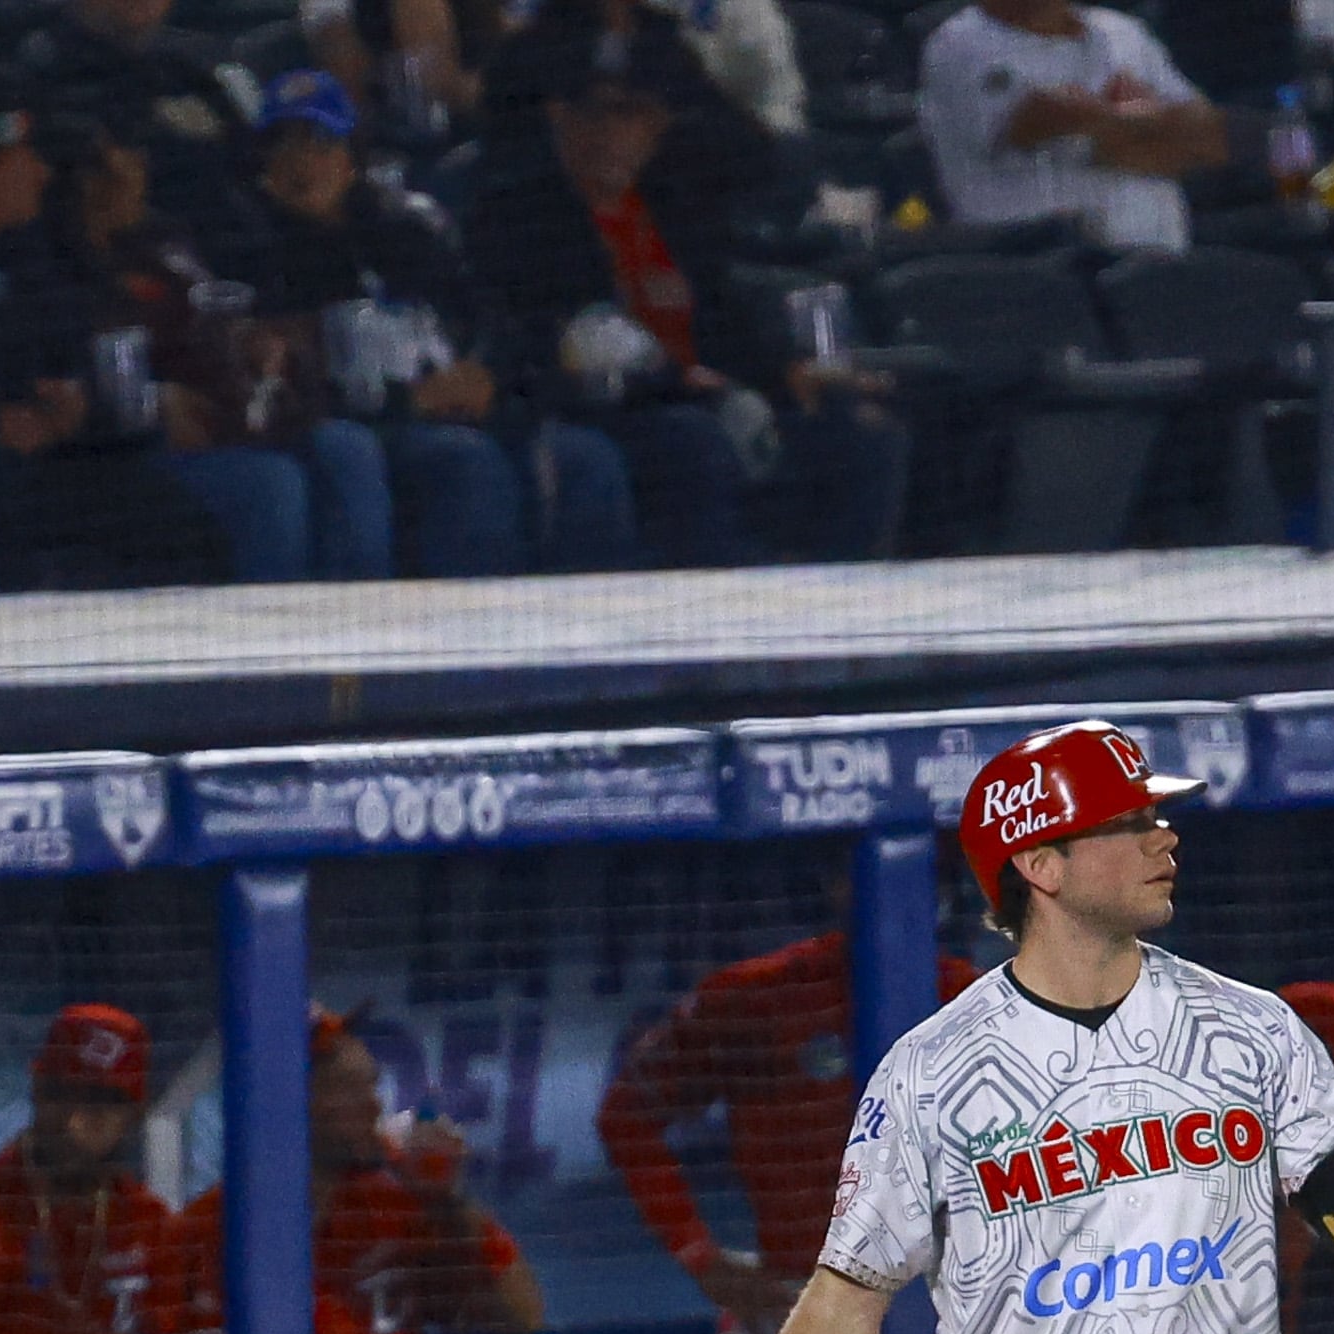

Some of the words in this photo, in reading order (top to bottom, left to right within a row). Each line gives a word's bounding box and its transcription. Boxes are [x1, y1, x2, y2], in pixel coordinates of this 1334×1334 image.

[755, 740, 891, 788] TUDN
[1101, 733, 1153, 780] M
[979, 762, 1049, 827] Red
[1000, 808, 1048, 844] Cola
[970, 1104, 1269, 1219] MÉXICO
[1024, 1216, 1244, 1317] Comex
